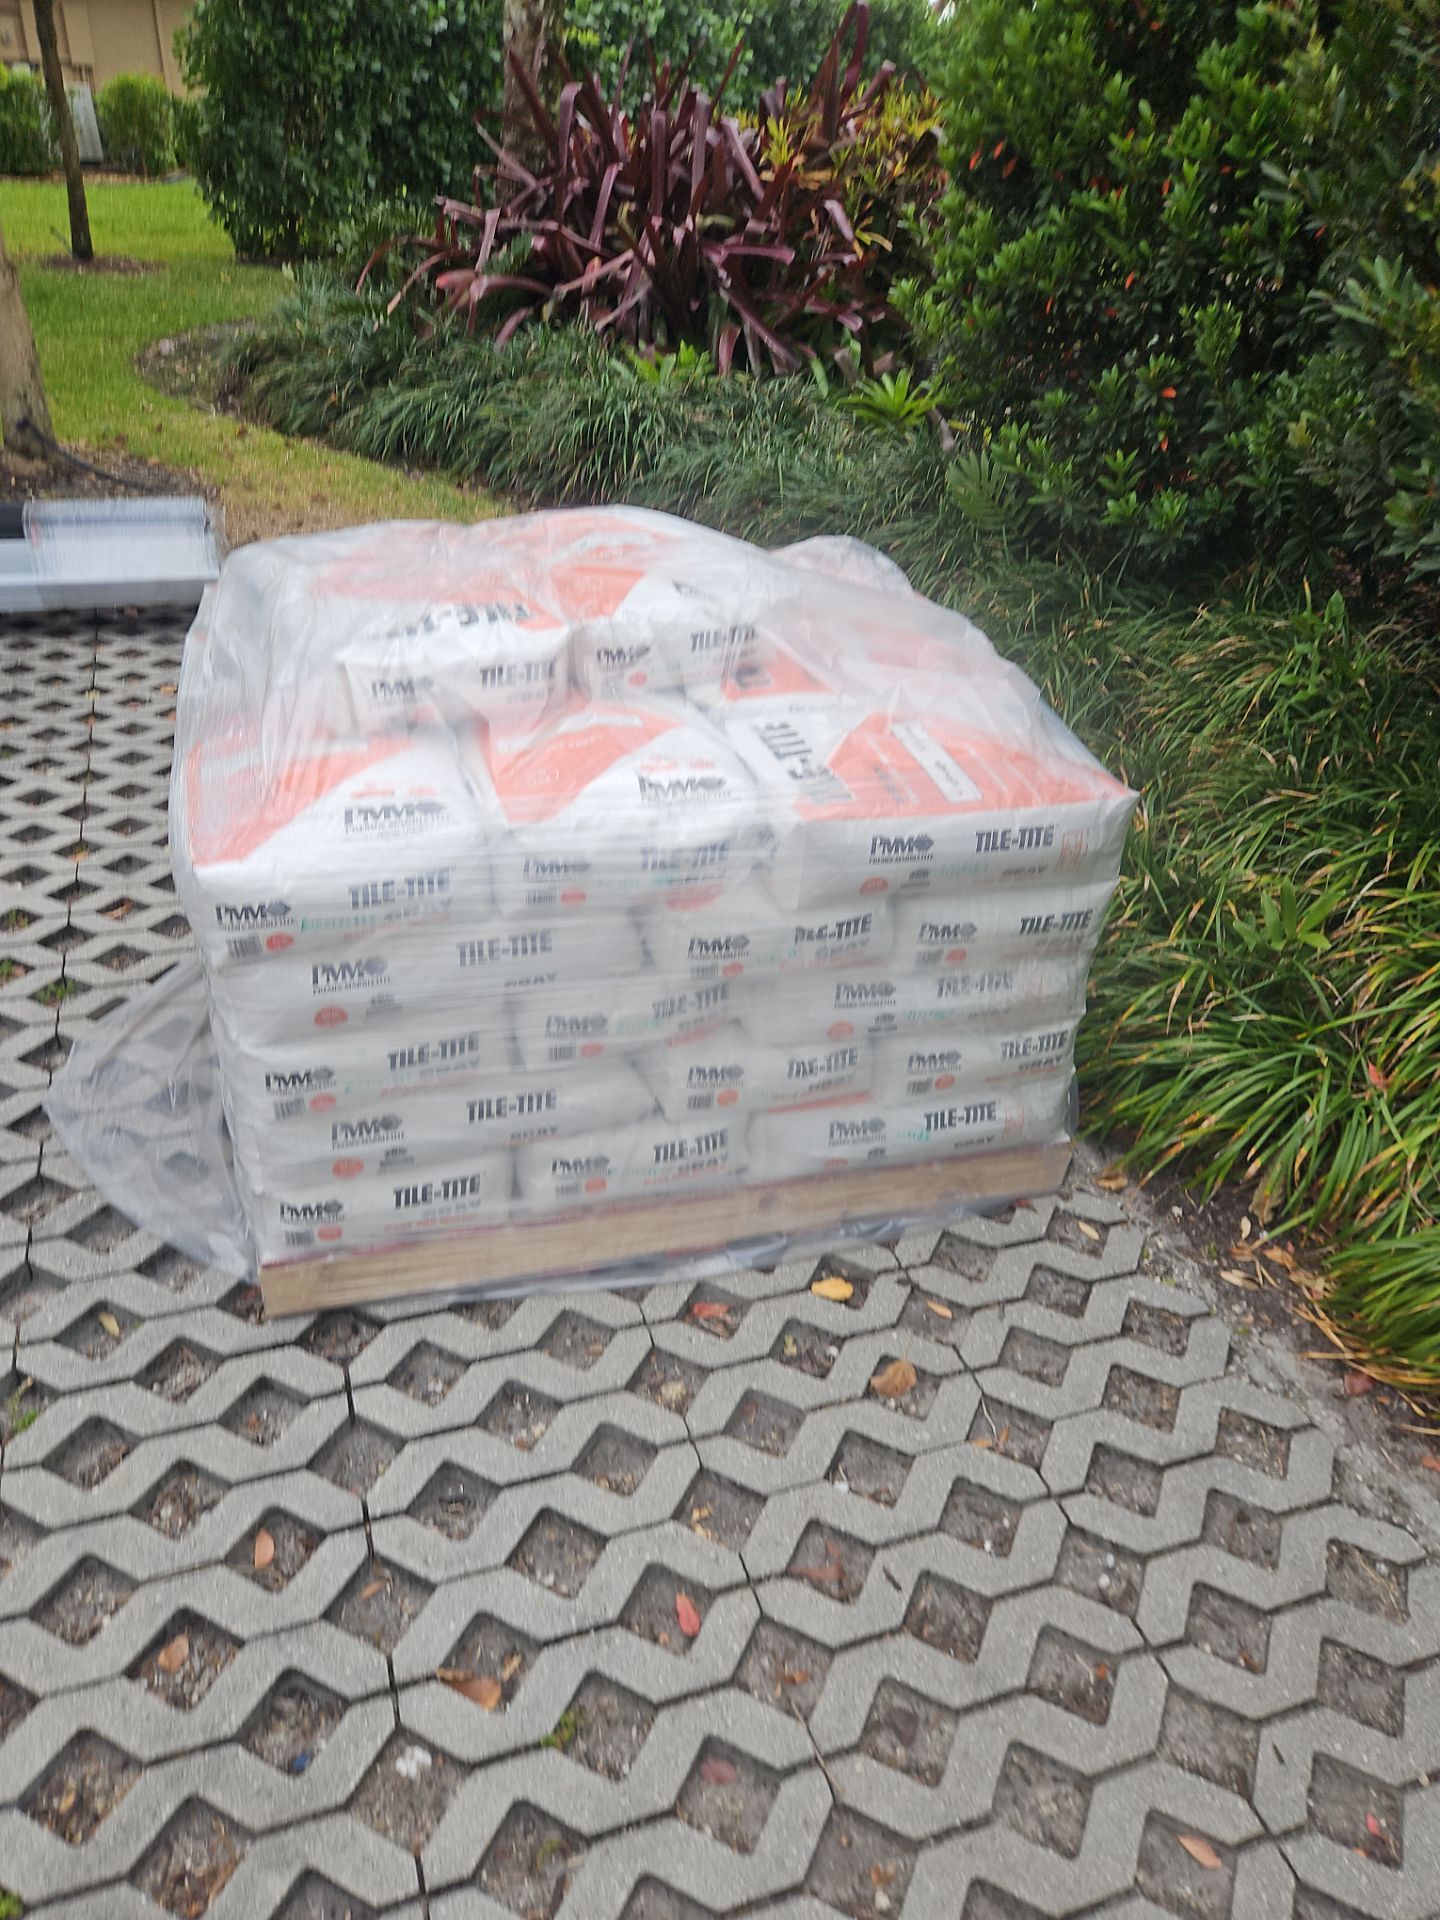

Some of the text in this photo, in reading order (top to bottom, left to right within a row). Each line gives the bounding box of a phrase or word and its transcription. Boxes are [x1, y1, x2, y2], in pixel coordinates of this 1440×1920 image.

[870, 836, 915, 855] PMM
[975, 826, 1055, 853] TILE-TITE
[349, 868, 450, 910] TILE-TITE
[1019, 910, 1093, 936] TILE-TITE
[456, 931, 552, 968] TILE-TITE
[312, 960, 364, 985] PMM
[388, 1033, 479, 1073] TILE-TITE
[1002, 1030, 1068, 1060] TILE-TITE
[467, 1089, 556, 1124] TILE-TITE
[924, 1101, 997, 1132] TILE-TITE
[332, 1116, 381, 1142] PMM
[653, 1128, 728, 1163] TILE-TITE
[393, 1173, 480, 1210] TILE-TITE
